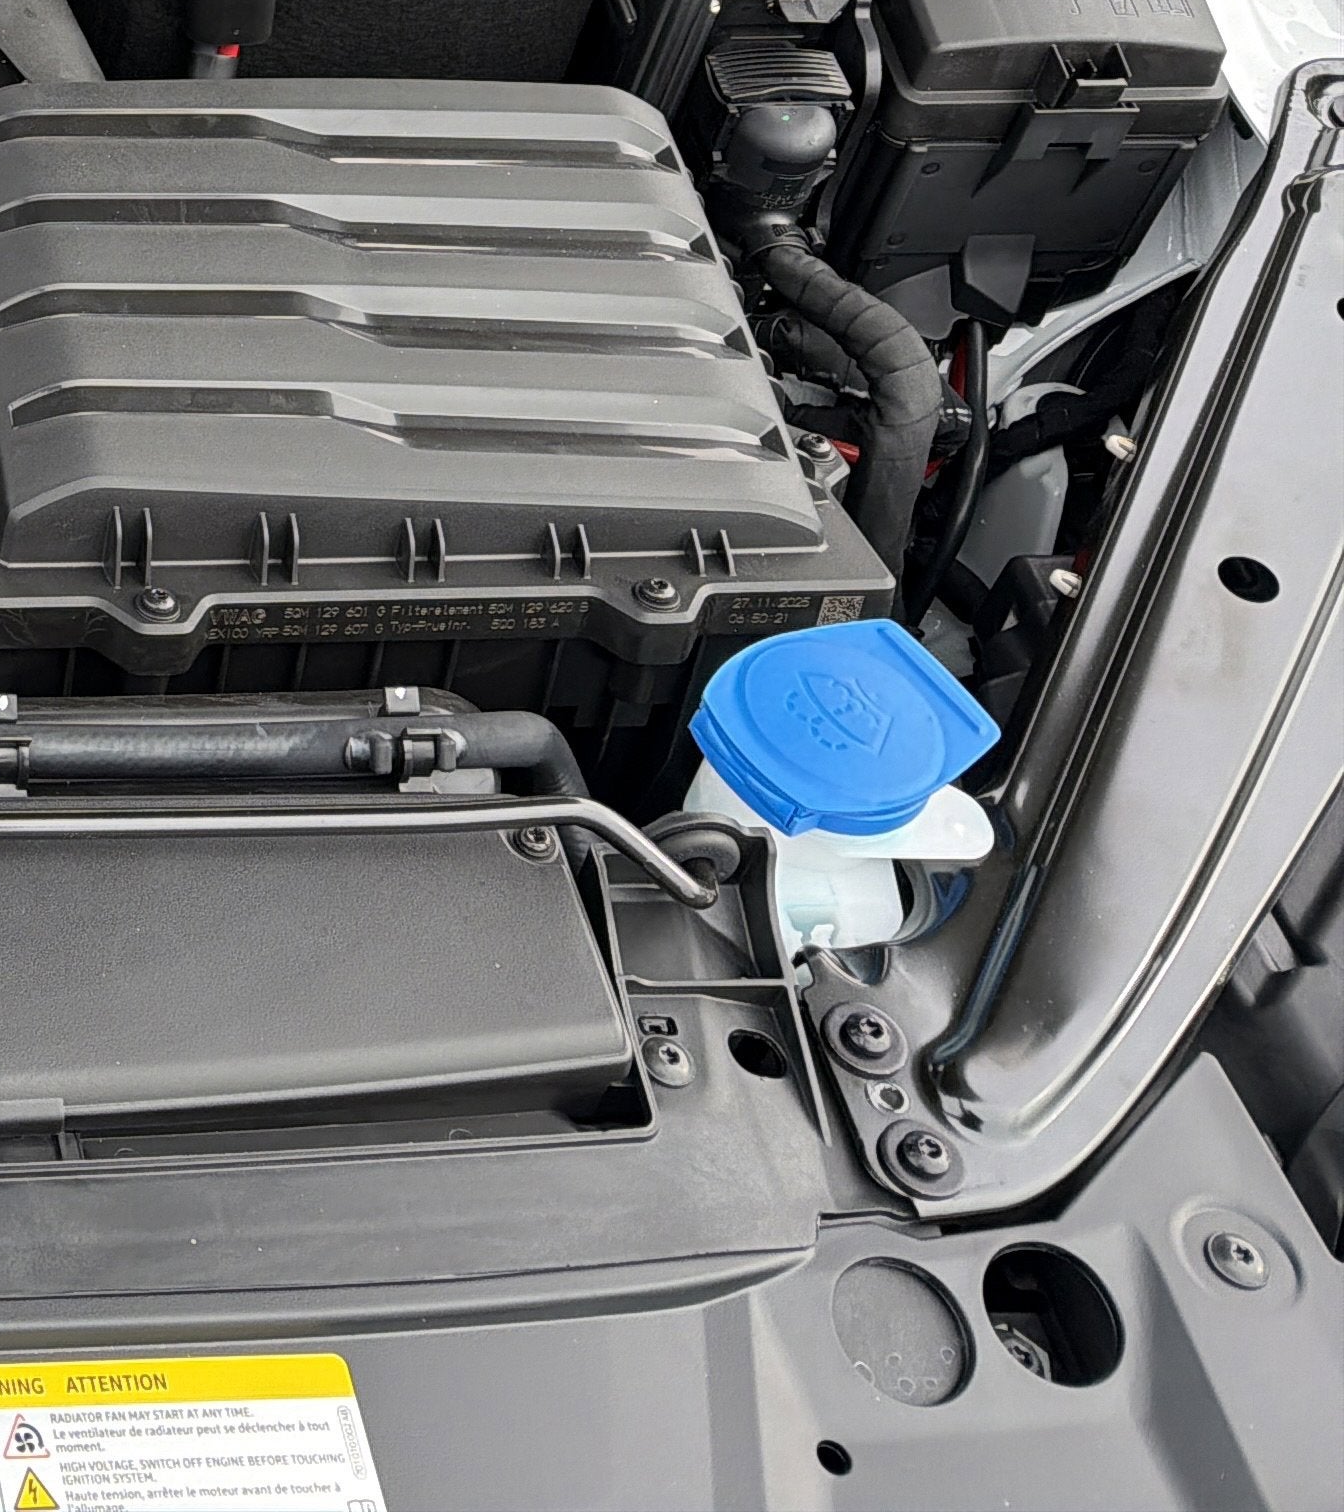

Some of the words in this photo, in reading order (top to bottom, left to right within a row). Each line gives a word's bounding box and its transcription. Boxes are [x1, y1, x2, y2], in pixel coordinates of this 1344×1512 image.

[66, 1373, 168, 1394] ATTENTION
[49, 1411, 103, 1424] RADIATOR
[105, 1411, 126, 1422] FAN
[127, 1410, 151, 1421] MAY
[152, 1409, 184, 1421] START
[186, 1408, 200, 1420] AT
[202, 1408, 223, 1419] ANY
[52, 1429, 66, 1440] Le
[68, 1427, 126, 1439] ventilateur
[128, 1425, 143, 1437] de
[144, 1424, 193, 1436] radiateur
[196, 1424, 221, 1437] peut
[223, 1424, 236, 1434] se
[238, 1421, 295, 1434] déclencher
[307, 1421, 330, 1432] tout
[55, 1442, 106, 1453] moment.
[59, 1461, 86, 1473] HIGH
[139, 1458, 181, 1470] SWITCH
[182, 1457, 203, 1469] OFF
[205, 1455, 244, 1468] ENGINE
[247, 1454, 289, 1467] BEFORE
[290, 1453, 346, 1466] TOUCHING
[62, 1473, 111, 1486] IGNITION
[113, 1472, 157, 1484] SYSTEM.
[65, 1489, 99, 1502] Haute
[146, 1486, 184, 1498] arrêter
[186, 1485, 197, 1497] le
[199, 1486, 238, 1497] moteur
[242, 1485, 272, 1496] avant
[275, 1483, 288, 1494] de
[290, 1482, 331, 1494] toucher
